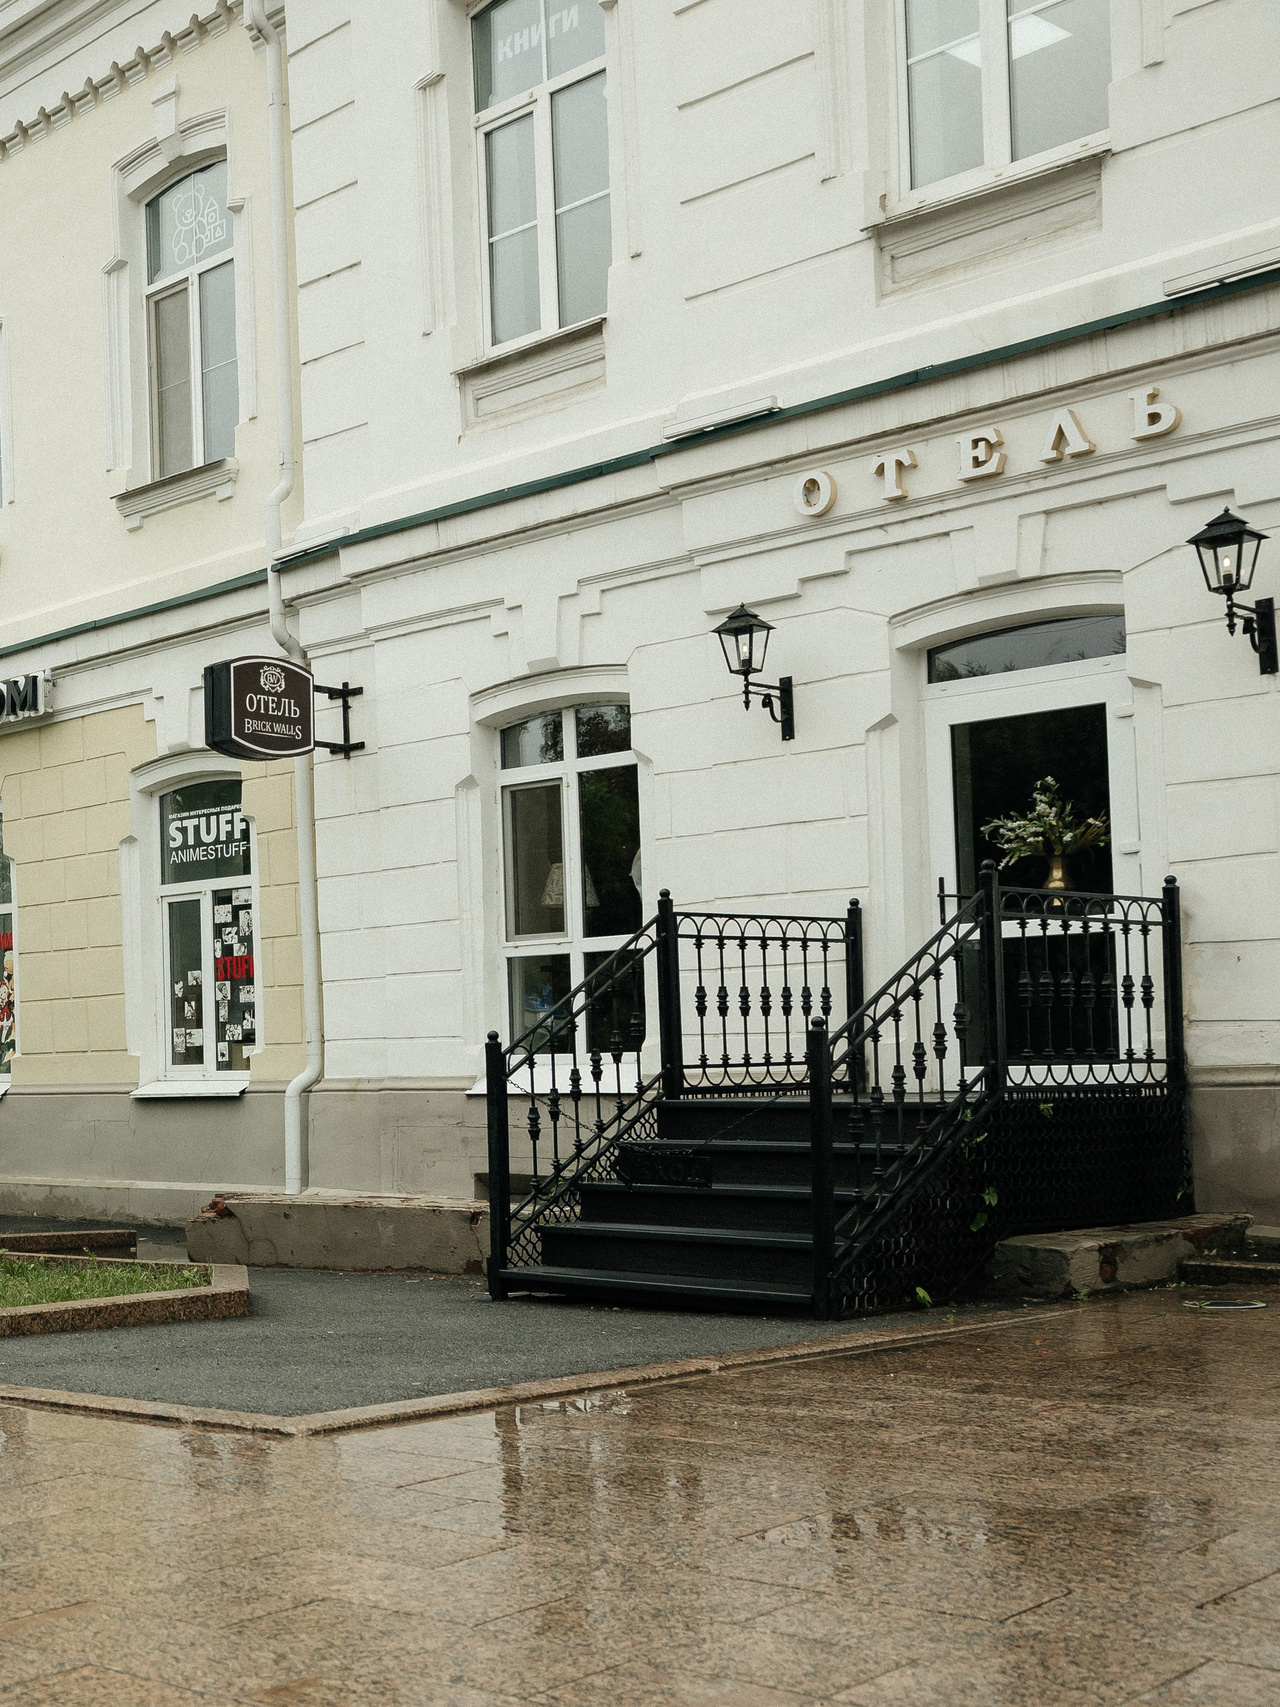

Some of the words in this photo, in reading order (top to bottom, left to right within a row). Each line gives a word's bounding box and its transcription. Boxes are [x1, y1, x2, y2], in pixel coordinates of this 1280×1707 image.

[498, 4, 578, 63] КНИГИ
[793, 387, 1181, 516] ОТЕЛЬ
[246, 693, 300, 718] ОТЕЛЬ
[244, 718, 272, 733] BRICK
[273, 722, 302, 740] WALLS
[169, 812, 246, 848] STUFF
[170, 842, 247, 864] ANIMESTUFF
